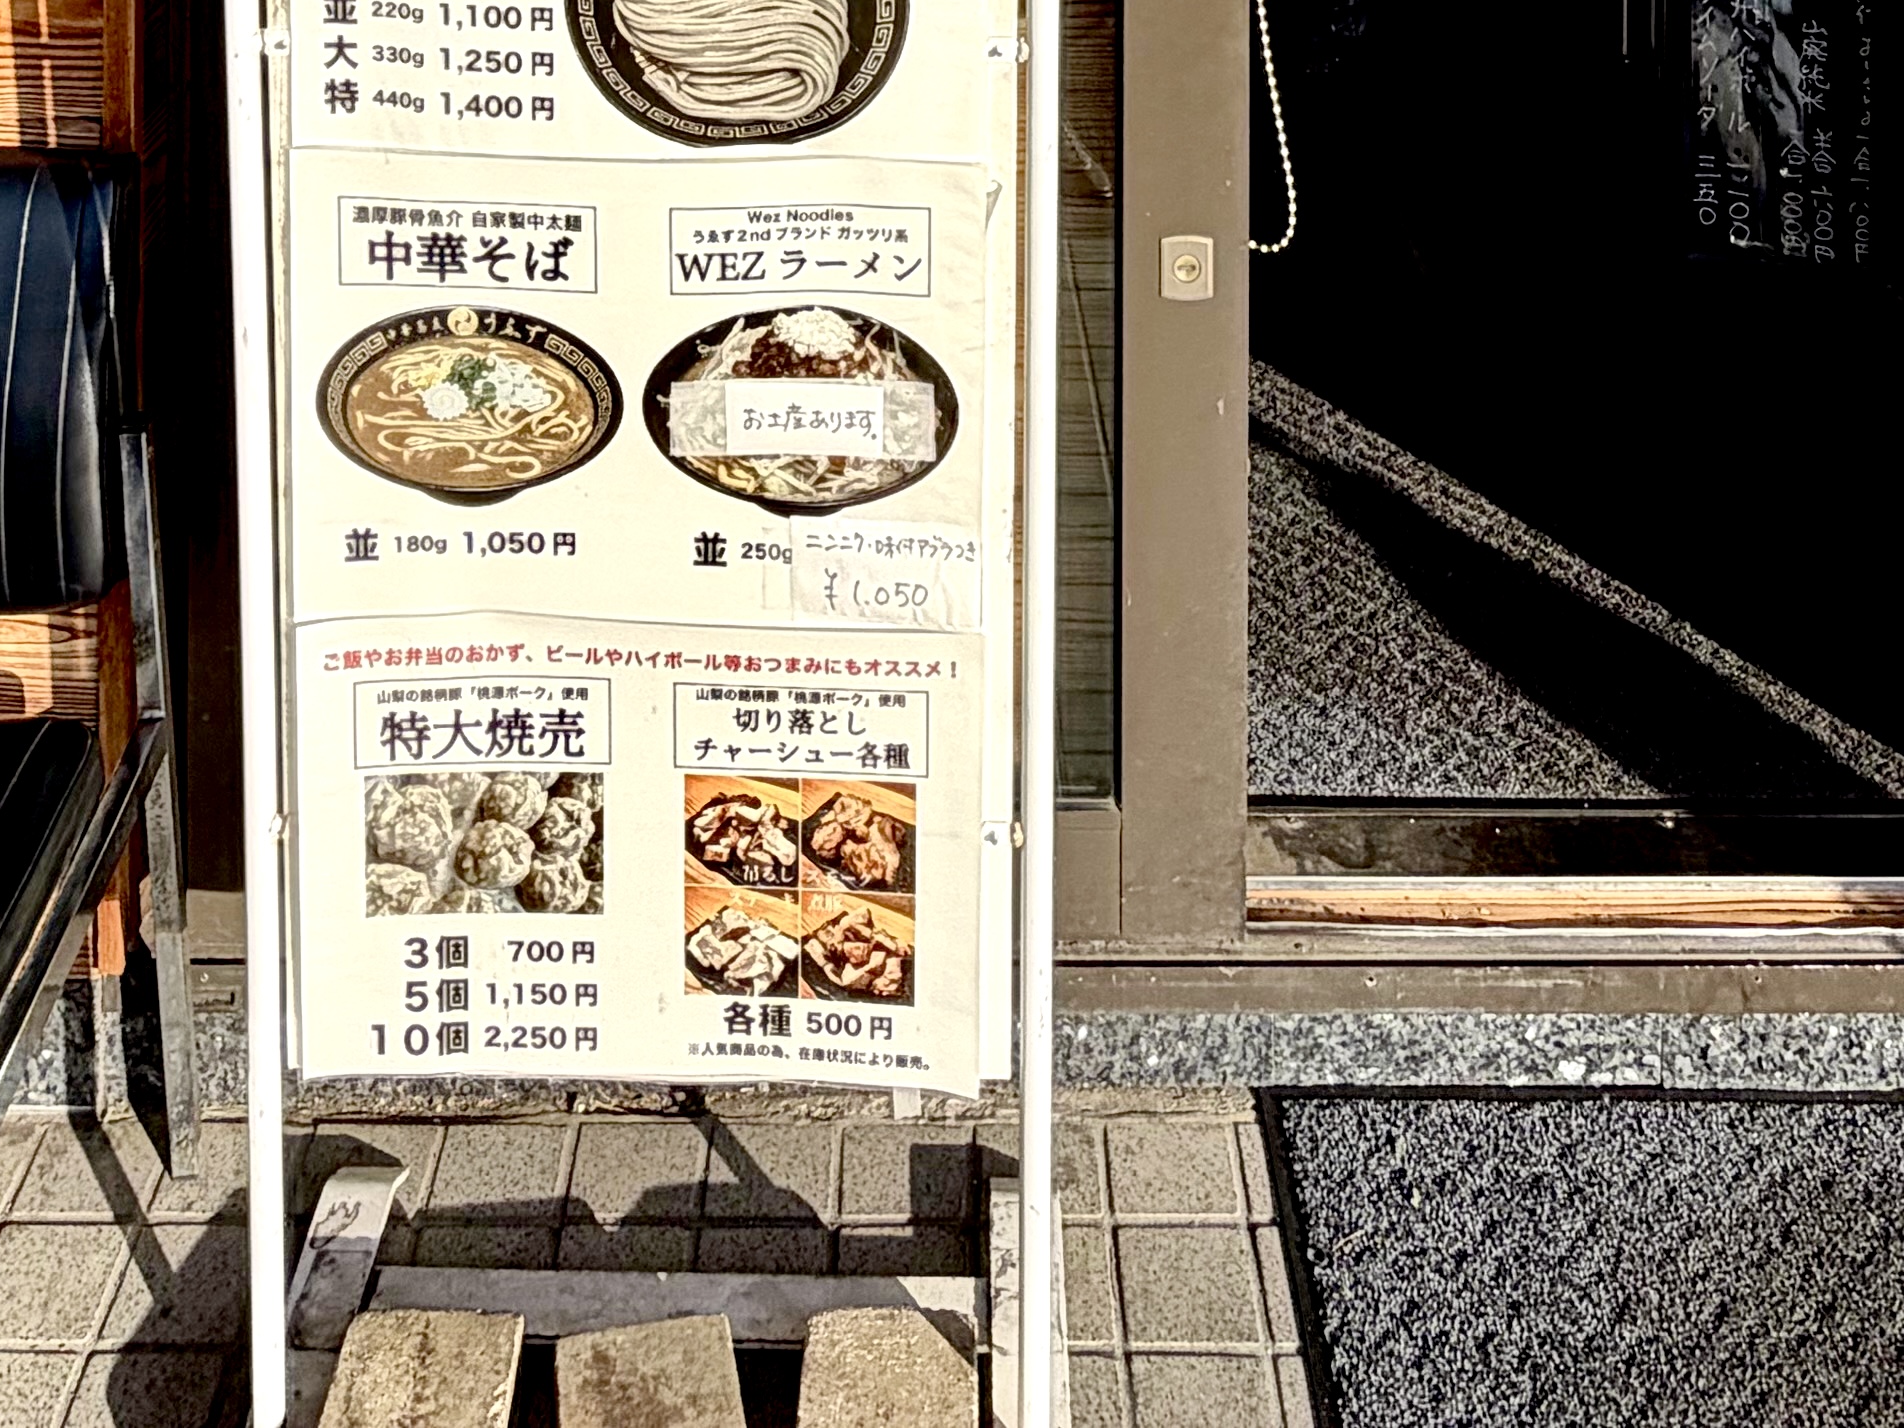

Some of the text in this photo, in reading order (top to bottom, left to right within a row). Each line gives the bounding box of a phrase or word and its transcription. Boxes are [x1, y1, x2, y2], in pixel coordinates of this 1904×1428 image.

[371, 1, 424, 24] 220g
[439, 3, 554, 31] 1,100円
[324, 35, 554, 76] 大 330g 1,250円
[324, 78, 555, 121] 特 440g 1,400円
[352, 205, 583, 233] 濃厚豚骨魚介 自家製中太麺
[747, 209, 854, 224] Wez Noodles
[776, 226, 833, 241] ブランド
[839, 226, 909, 243] ガッツリ系
[368, 230, 574, 282] 中華そば
[675, 249, 923, 282] WEZ ラーメン
[344, 527, 576, 562] 並 180g 1,050円
[693, 531, 792, 567] 並 250g
[380, 707, 587, 760] 特大焼売
[732, 707, 866, 735] 切り落とし
[694, 737, 911, 770] チャーシュー各種
[404, 936, 595, 969] 3個 700円
[404, 979, 598, 1012] 5個 1,150円
[723, 1001, 892, 1040] 各種 500円
[371, 1021, 598, 1056] 10個 2,250円
